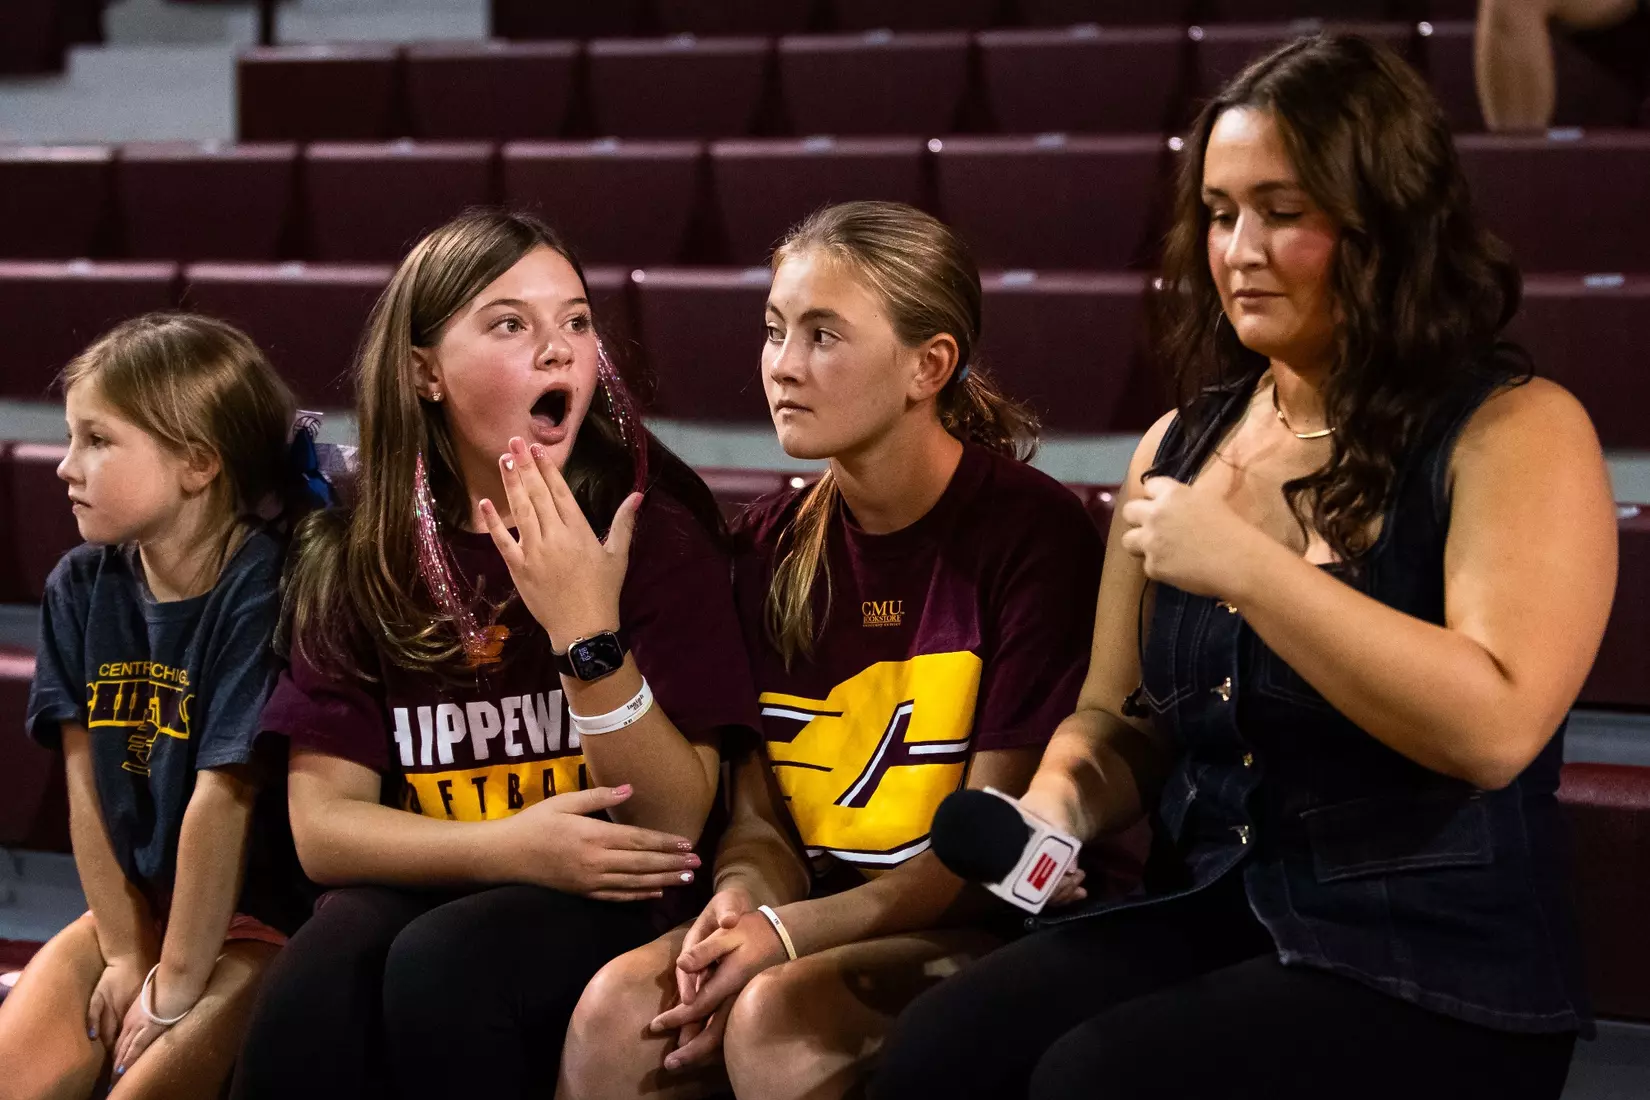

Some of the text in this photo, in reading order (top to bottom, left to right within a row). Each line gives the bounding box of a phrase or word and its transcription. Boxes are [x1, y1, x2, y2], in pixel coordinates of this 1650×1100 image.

[862, 600, 903, 616] CMU
[98, 661, 190, 686] CENTR CHIG
[393, 689, 581, 767] HIPPEW
